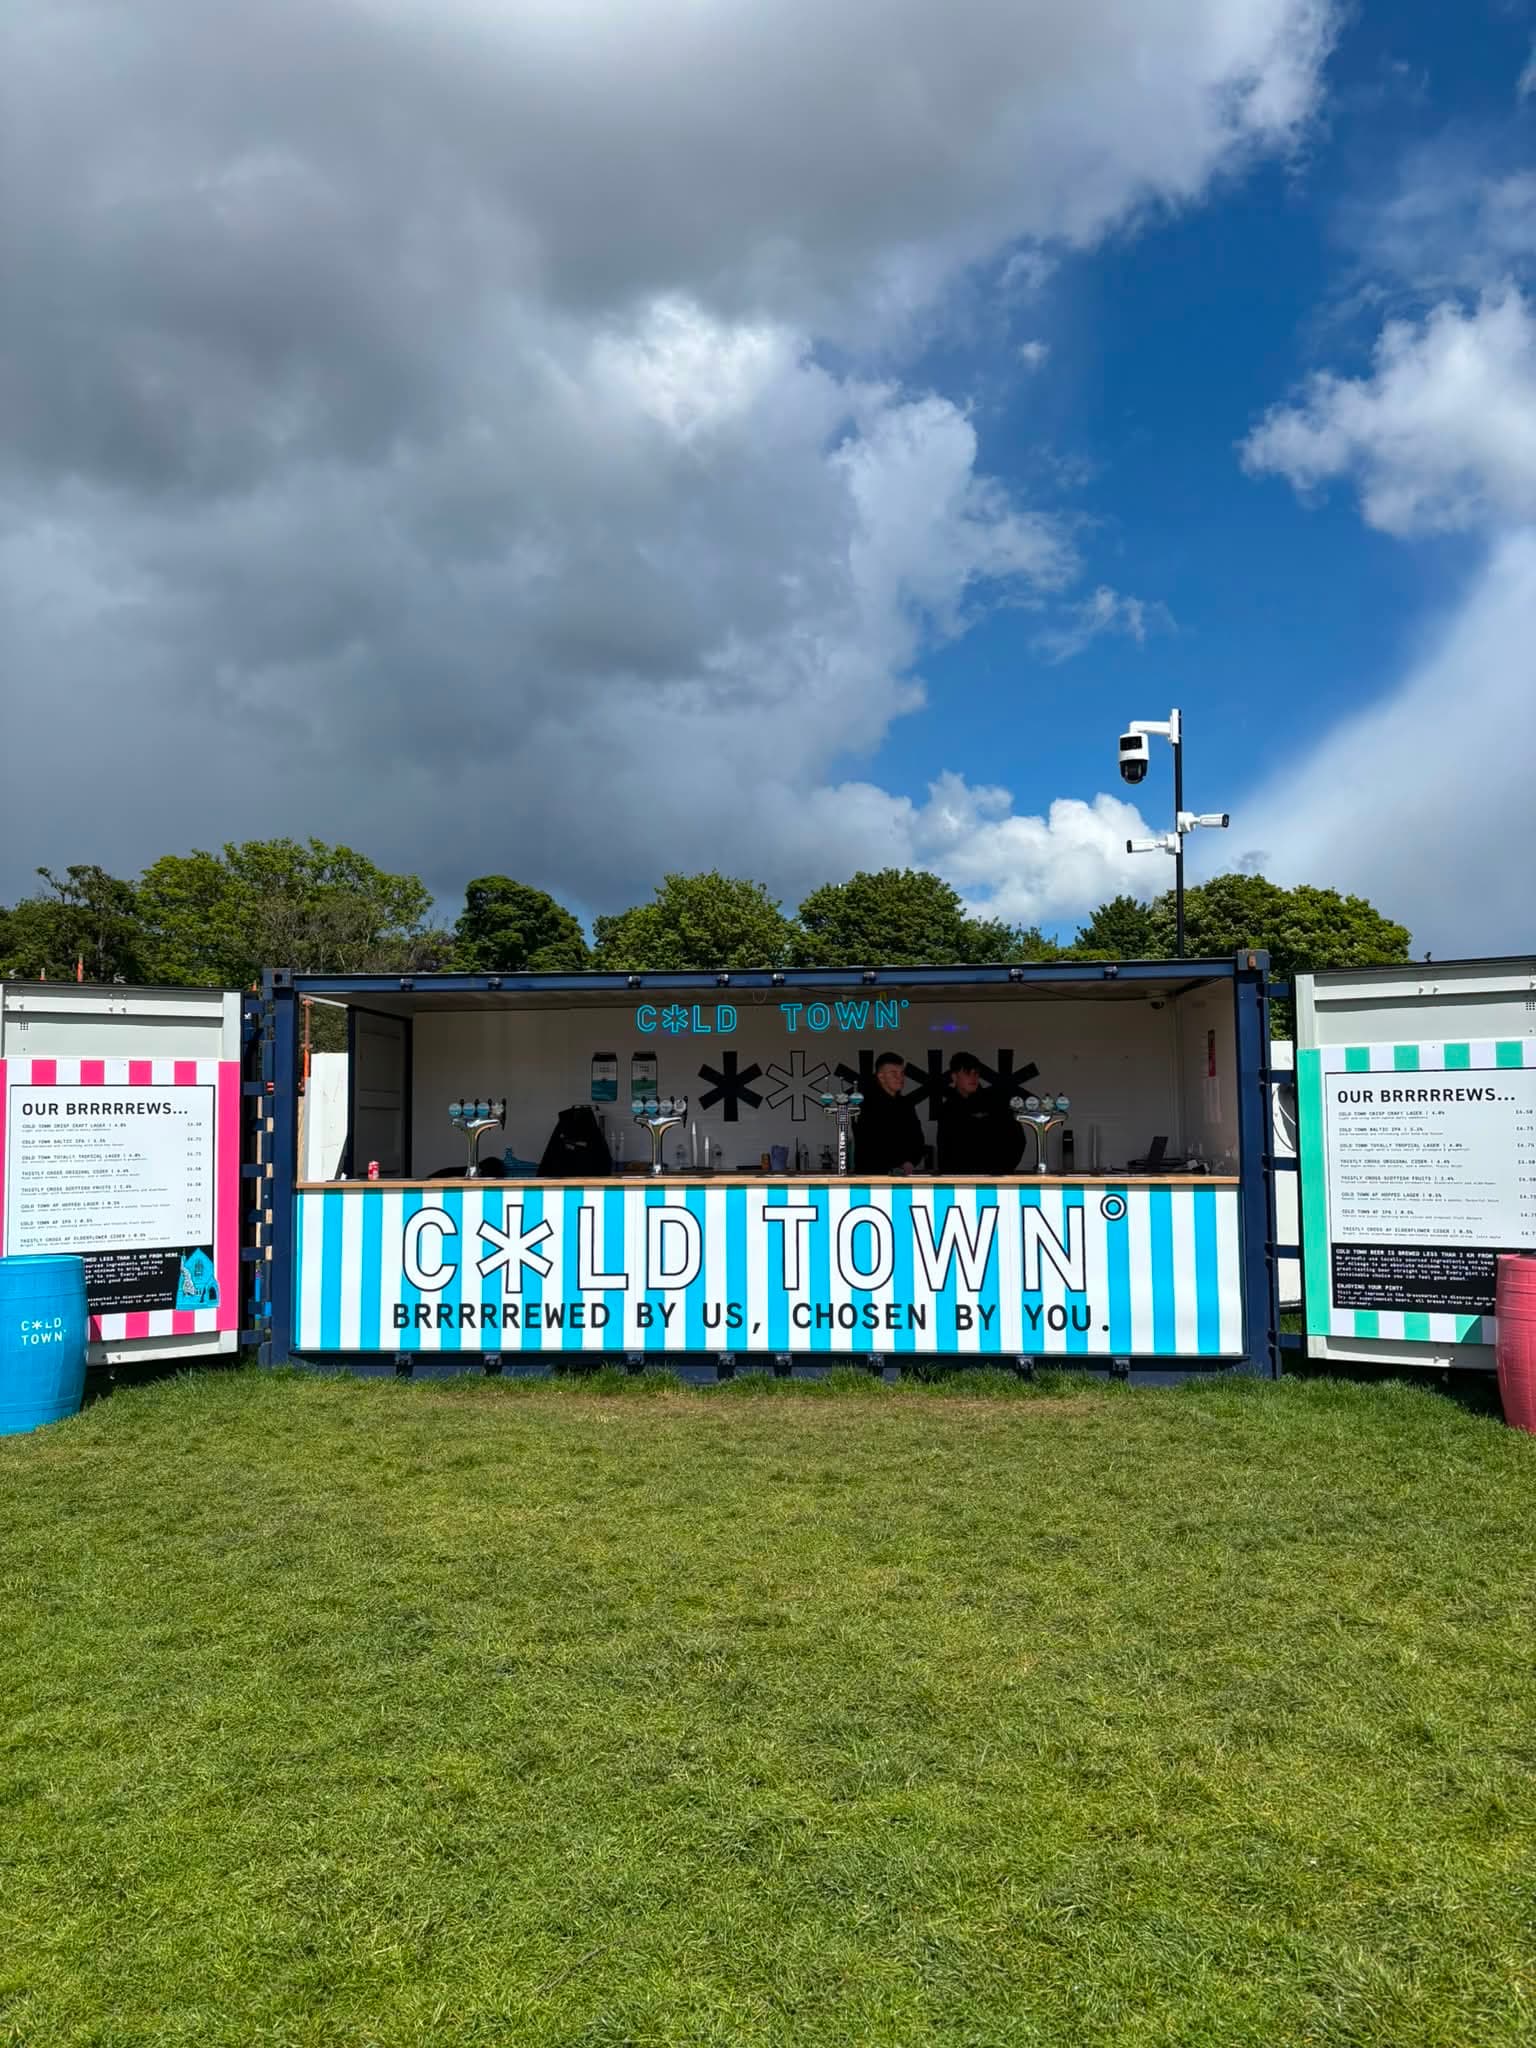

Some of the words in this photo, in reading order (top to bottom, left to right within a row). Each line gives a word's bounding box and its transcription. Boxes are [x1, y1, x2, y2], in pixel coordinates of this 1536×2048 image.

[1337, 1090, 1373, 1103] OUR
[22, 1102, 59, 1116] OUR
[393, 1303, 610, 1329] BRRRRREWED
[636, 1303, 676, 1328] BY
[702, 1303, 761, 1335] US,
[792, 1303, 927, 1330] CHOSEN
[955, 1304, 996, 1331] BY
[1025, 1304, 1110, 1332] YOU.
